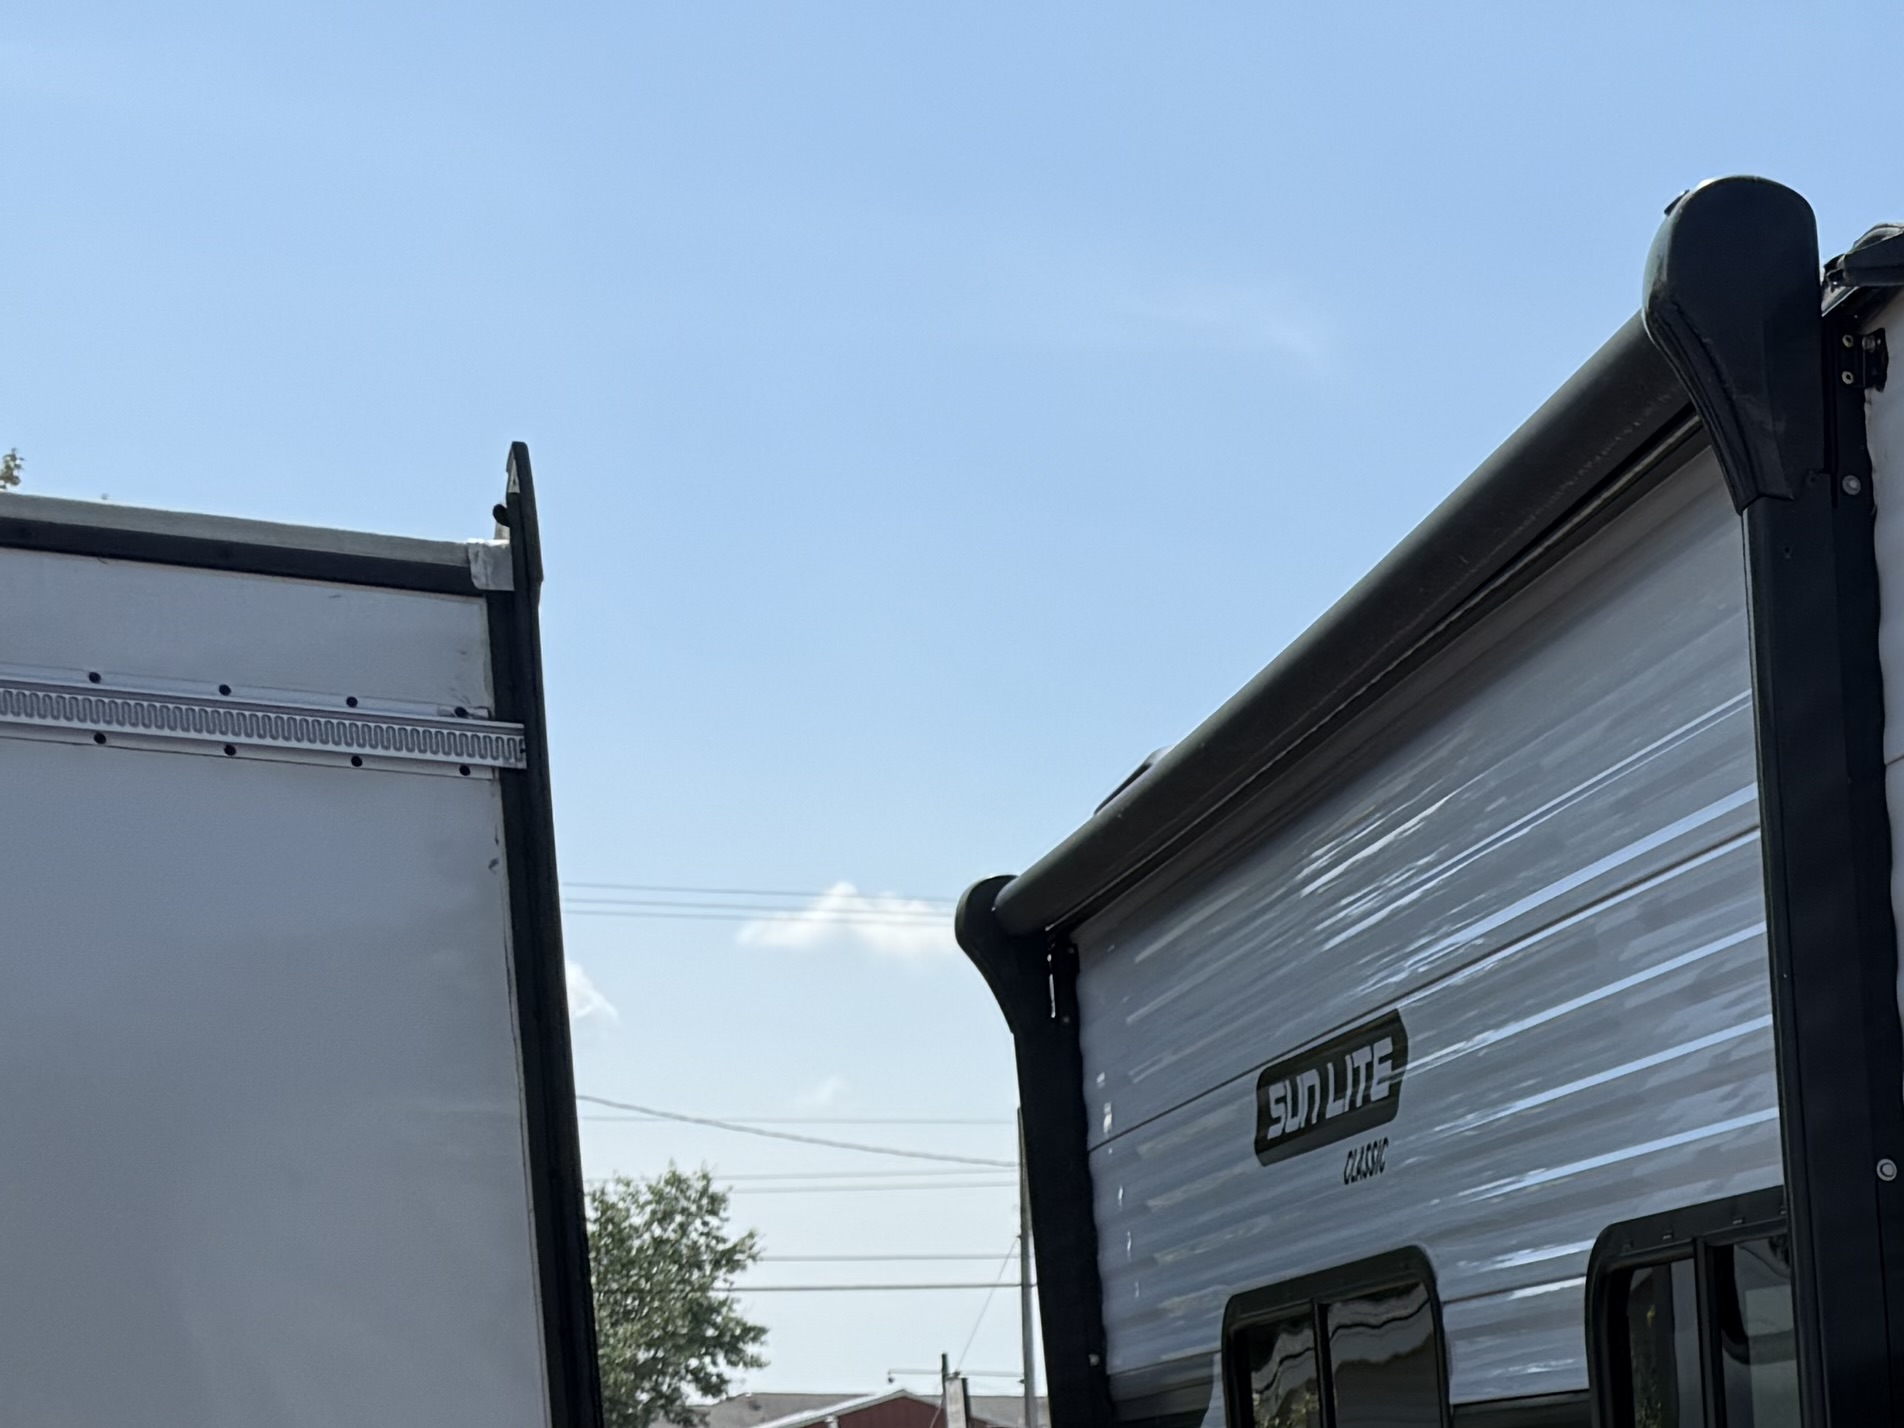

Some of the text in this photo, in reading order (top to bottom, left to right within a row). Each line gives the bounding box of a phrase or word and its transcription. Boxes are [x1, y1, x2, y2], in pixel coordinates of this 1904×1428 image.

[1267, 1036, 1394, 1140] SUN LITE
[1344, 1137, 1389, 1185] CLASSIC
